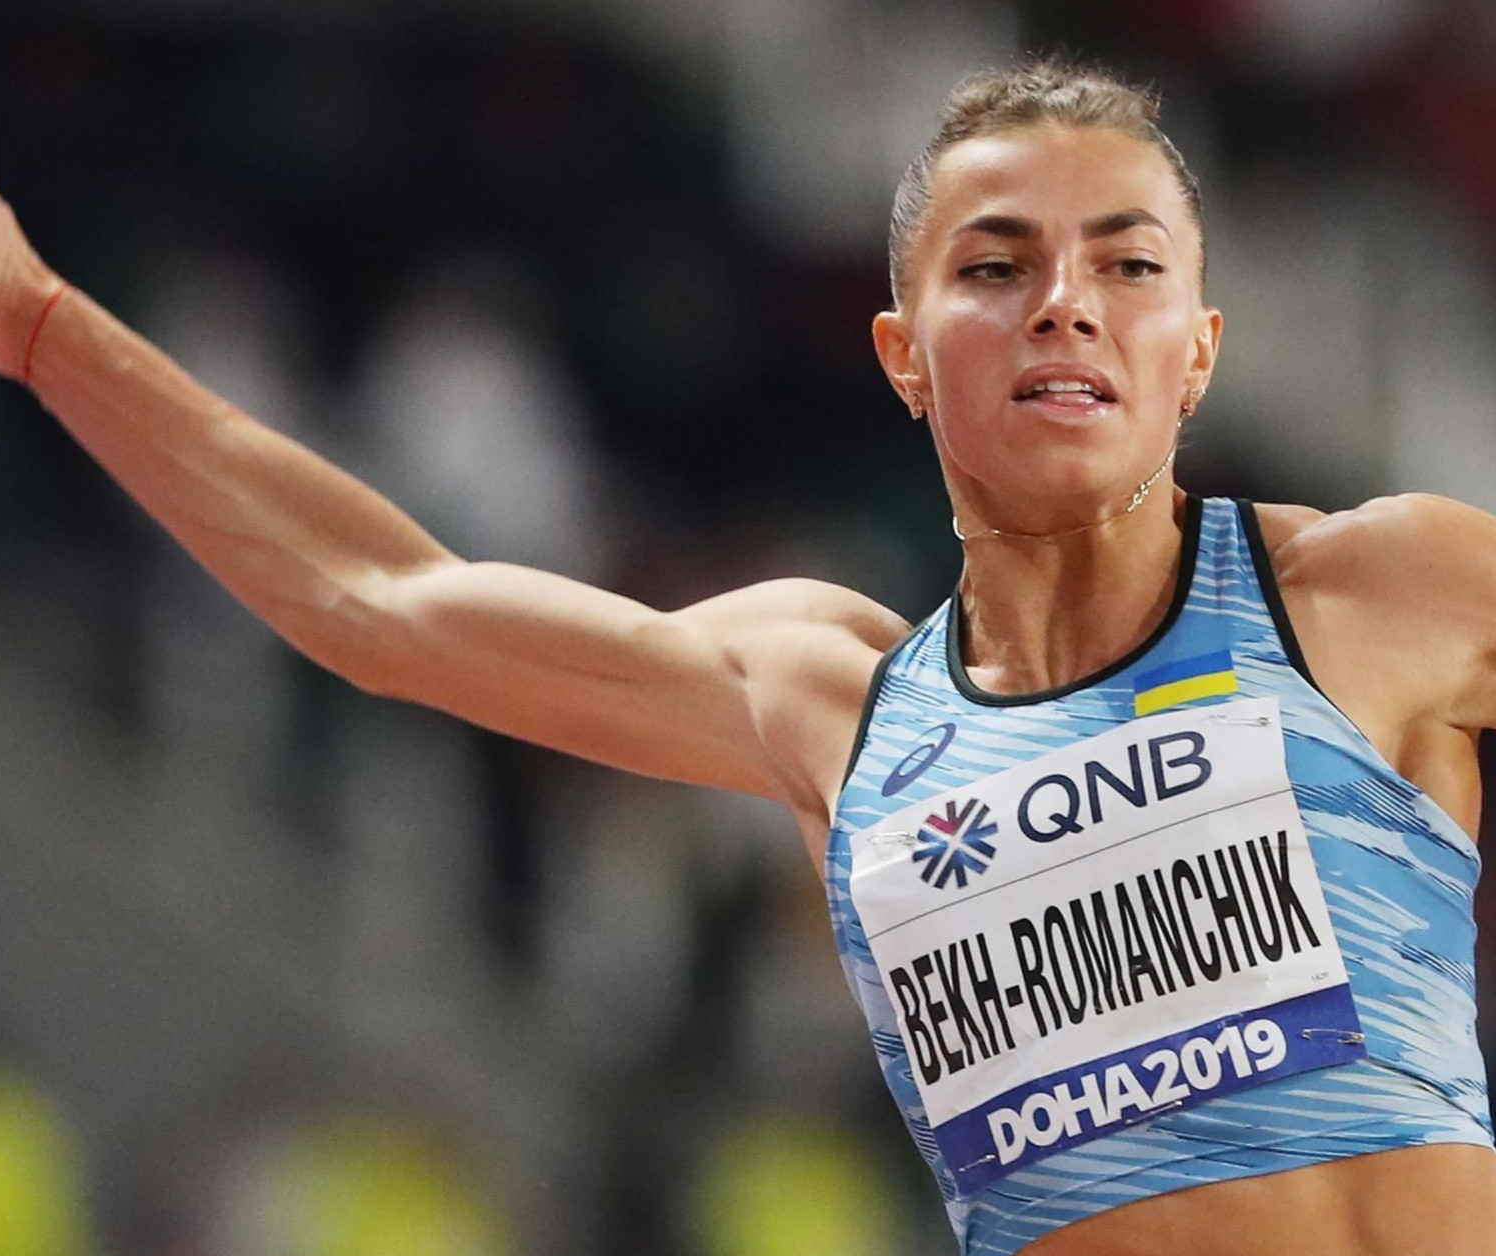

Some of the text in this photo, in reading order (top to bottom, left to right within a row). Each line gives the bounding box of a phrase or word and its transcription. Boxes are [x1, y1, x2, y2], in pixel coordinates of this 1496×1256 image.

[1017, 731, 1212, 843] QNB
[889, 830, 1321, 1086] BEKH-ROMANCHUK
[987, 1019, 1287, 1166] DOHA2019
